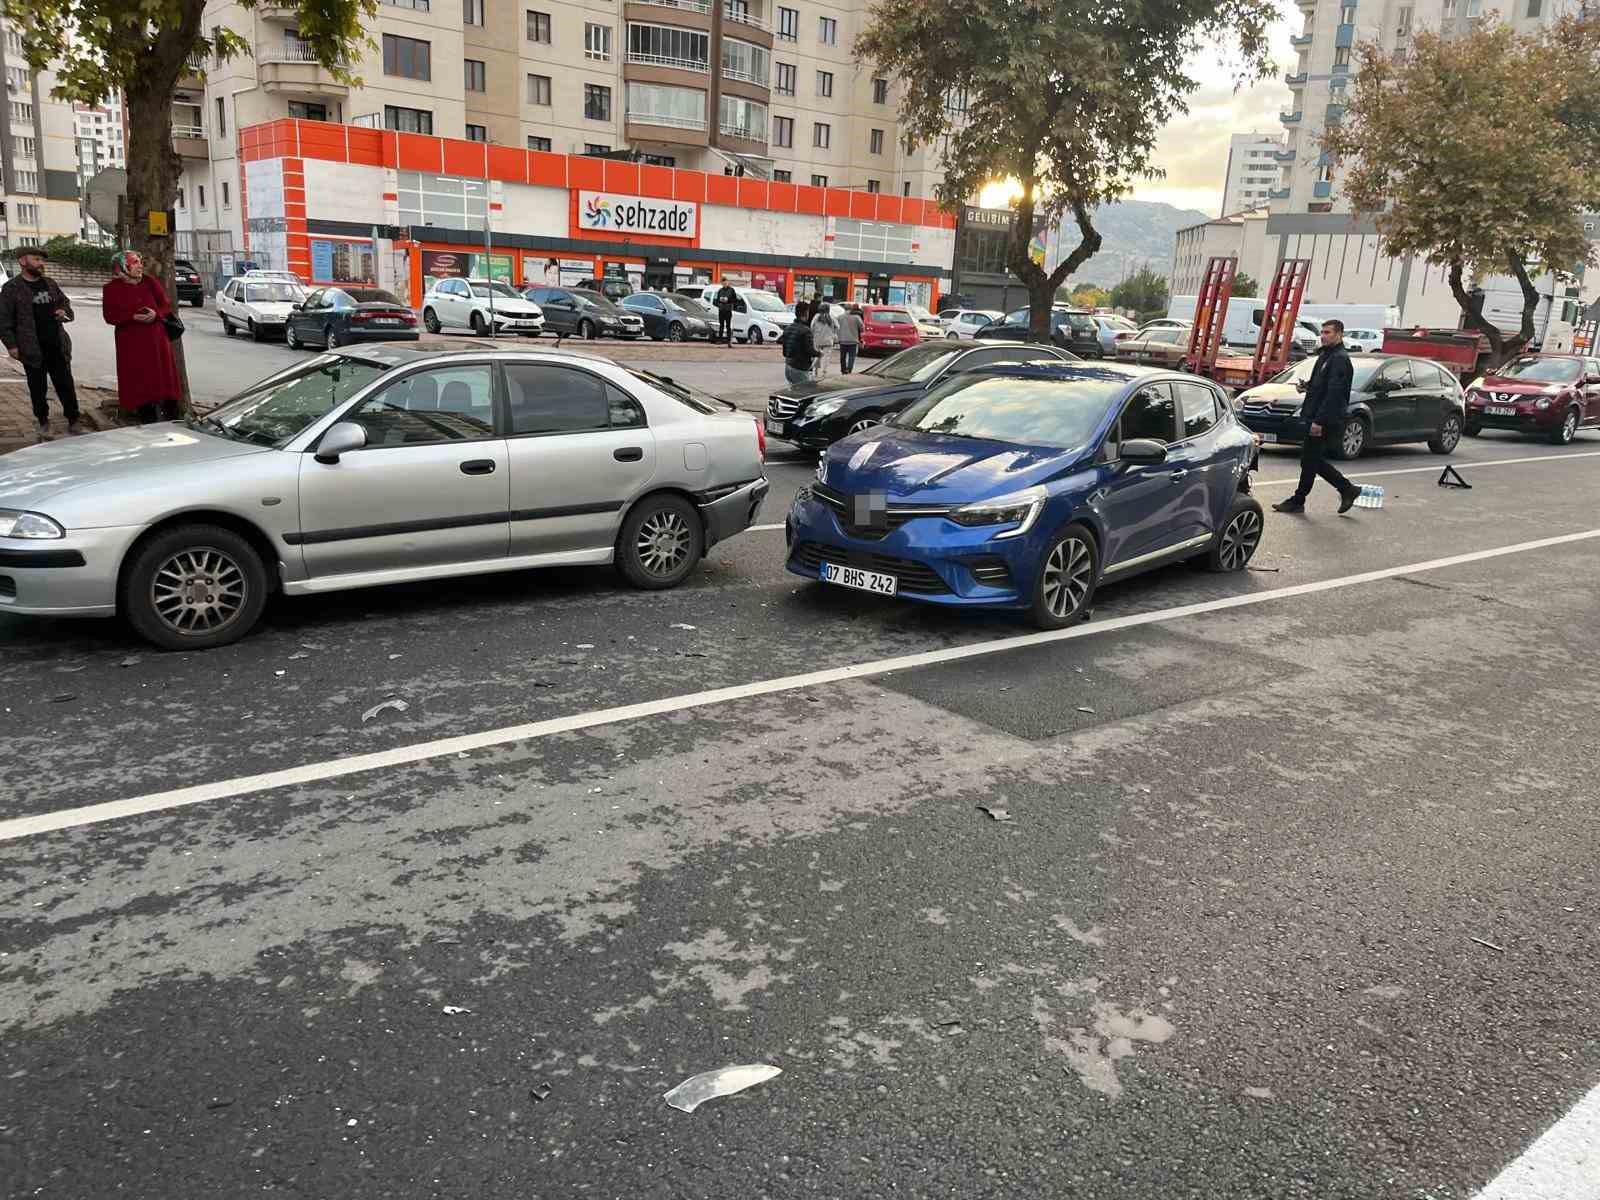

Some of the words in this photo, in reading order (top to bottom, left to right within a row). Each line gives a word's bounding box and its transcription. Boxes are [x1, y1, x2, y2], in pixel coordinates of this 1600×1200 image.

[614, 200, 689, 232] şehzade
[826, 565, 840, 581] 07
[843, 569, 865, 587] BHS
[870, 574, 893, 593] 242
